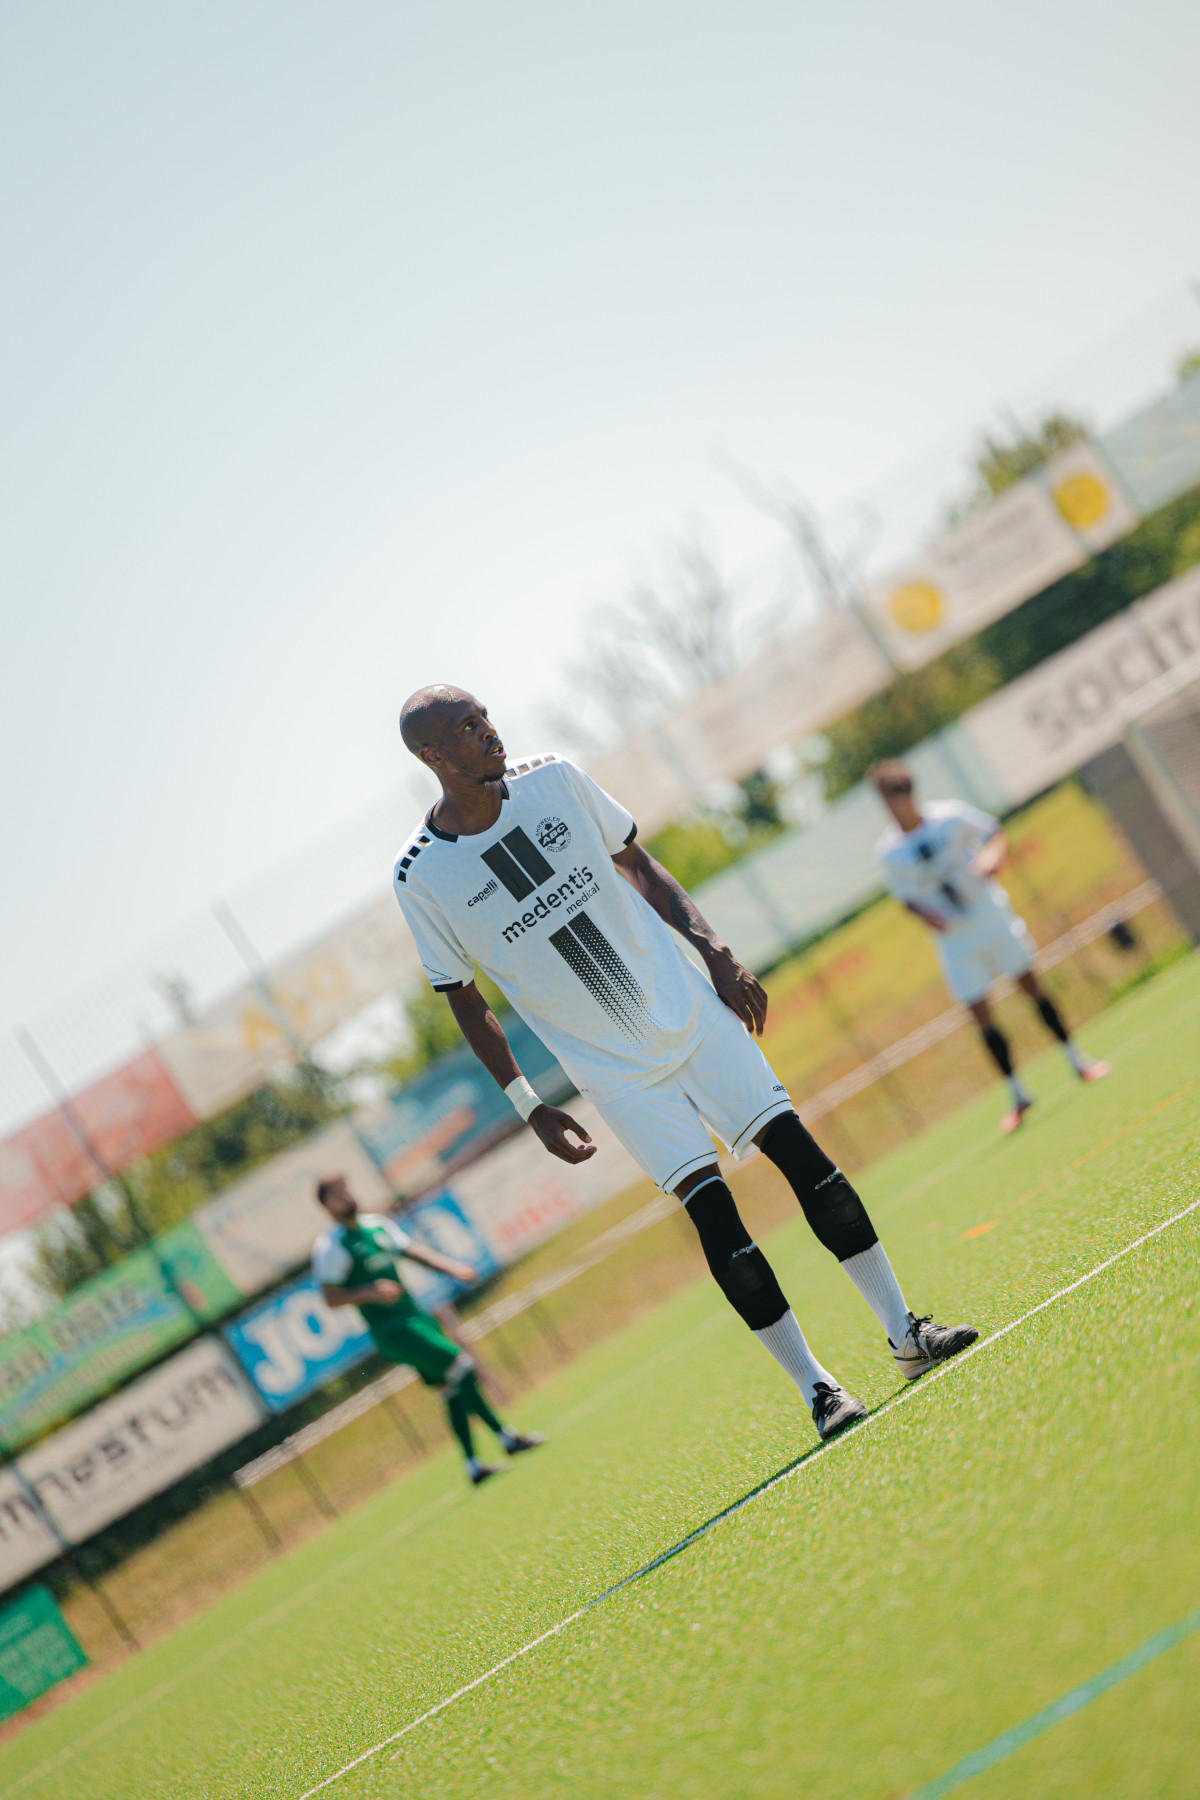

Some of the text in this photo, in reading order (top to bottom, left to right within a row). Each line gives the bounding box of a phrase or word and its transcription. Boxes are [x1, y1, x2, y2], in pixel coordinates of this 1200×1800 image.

[1022, 600, 1200, 750] SOCIT
[541, 823, 567, 848] ABC
[467, 879, 498, 907] capelli
[501, 866, 594, 944] medentis
[565, 882, 601, 915] medical
